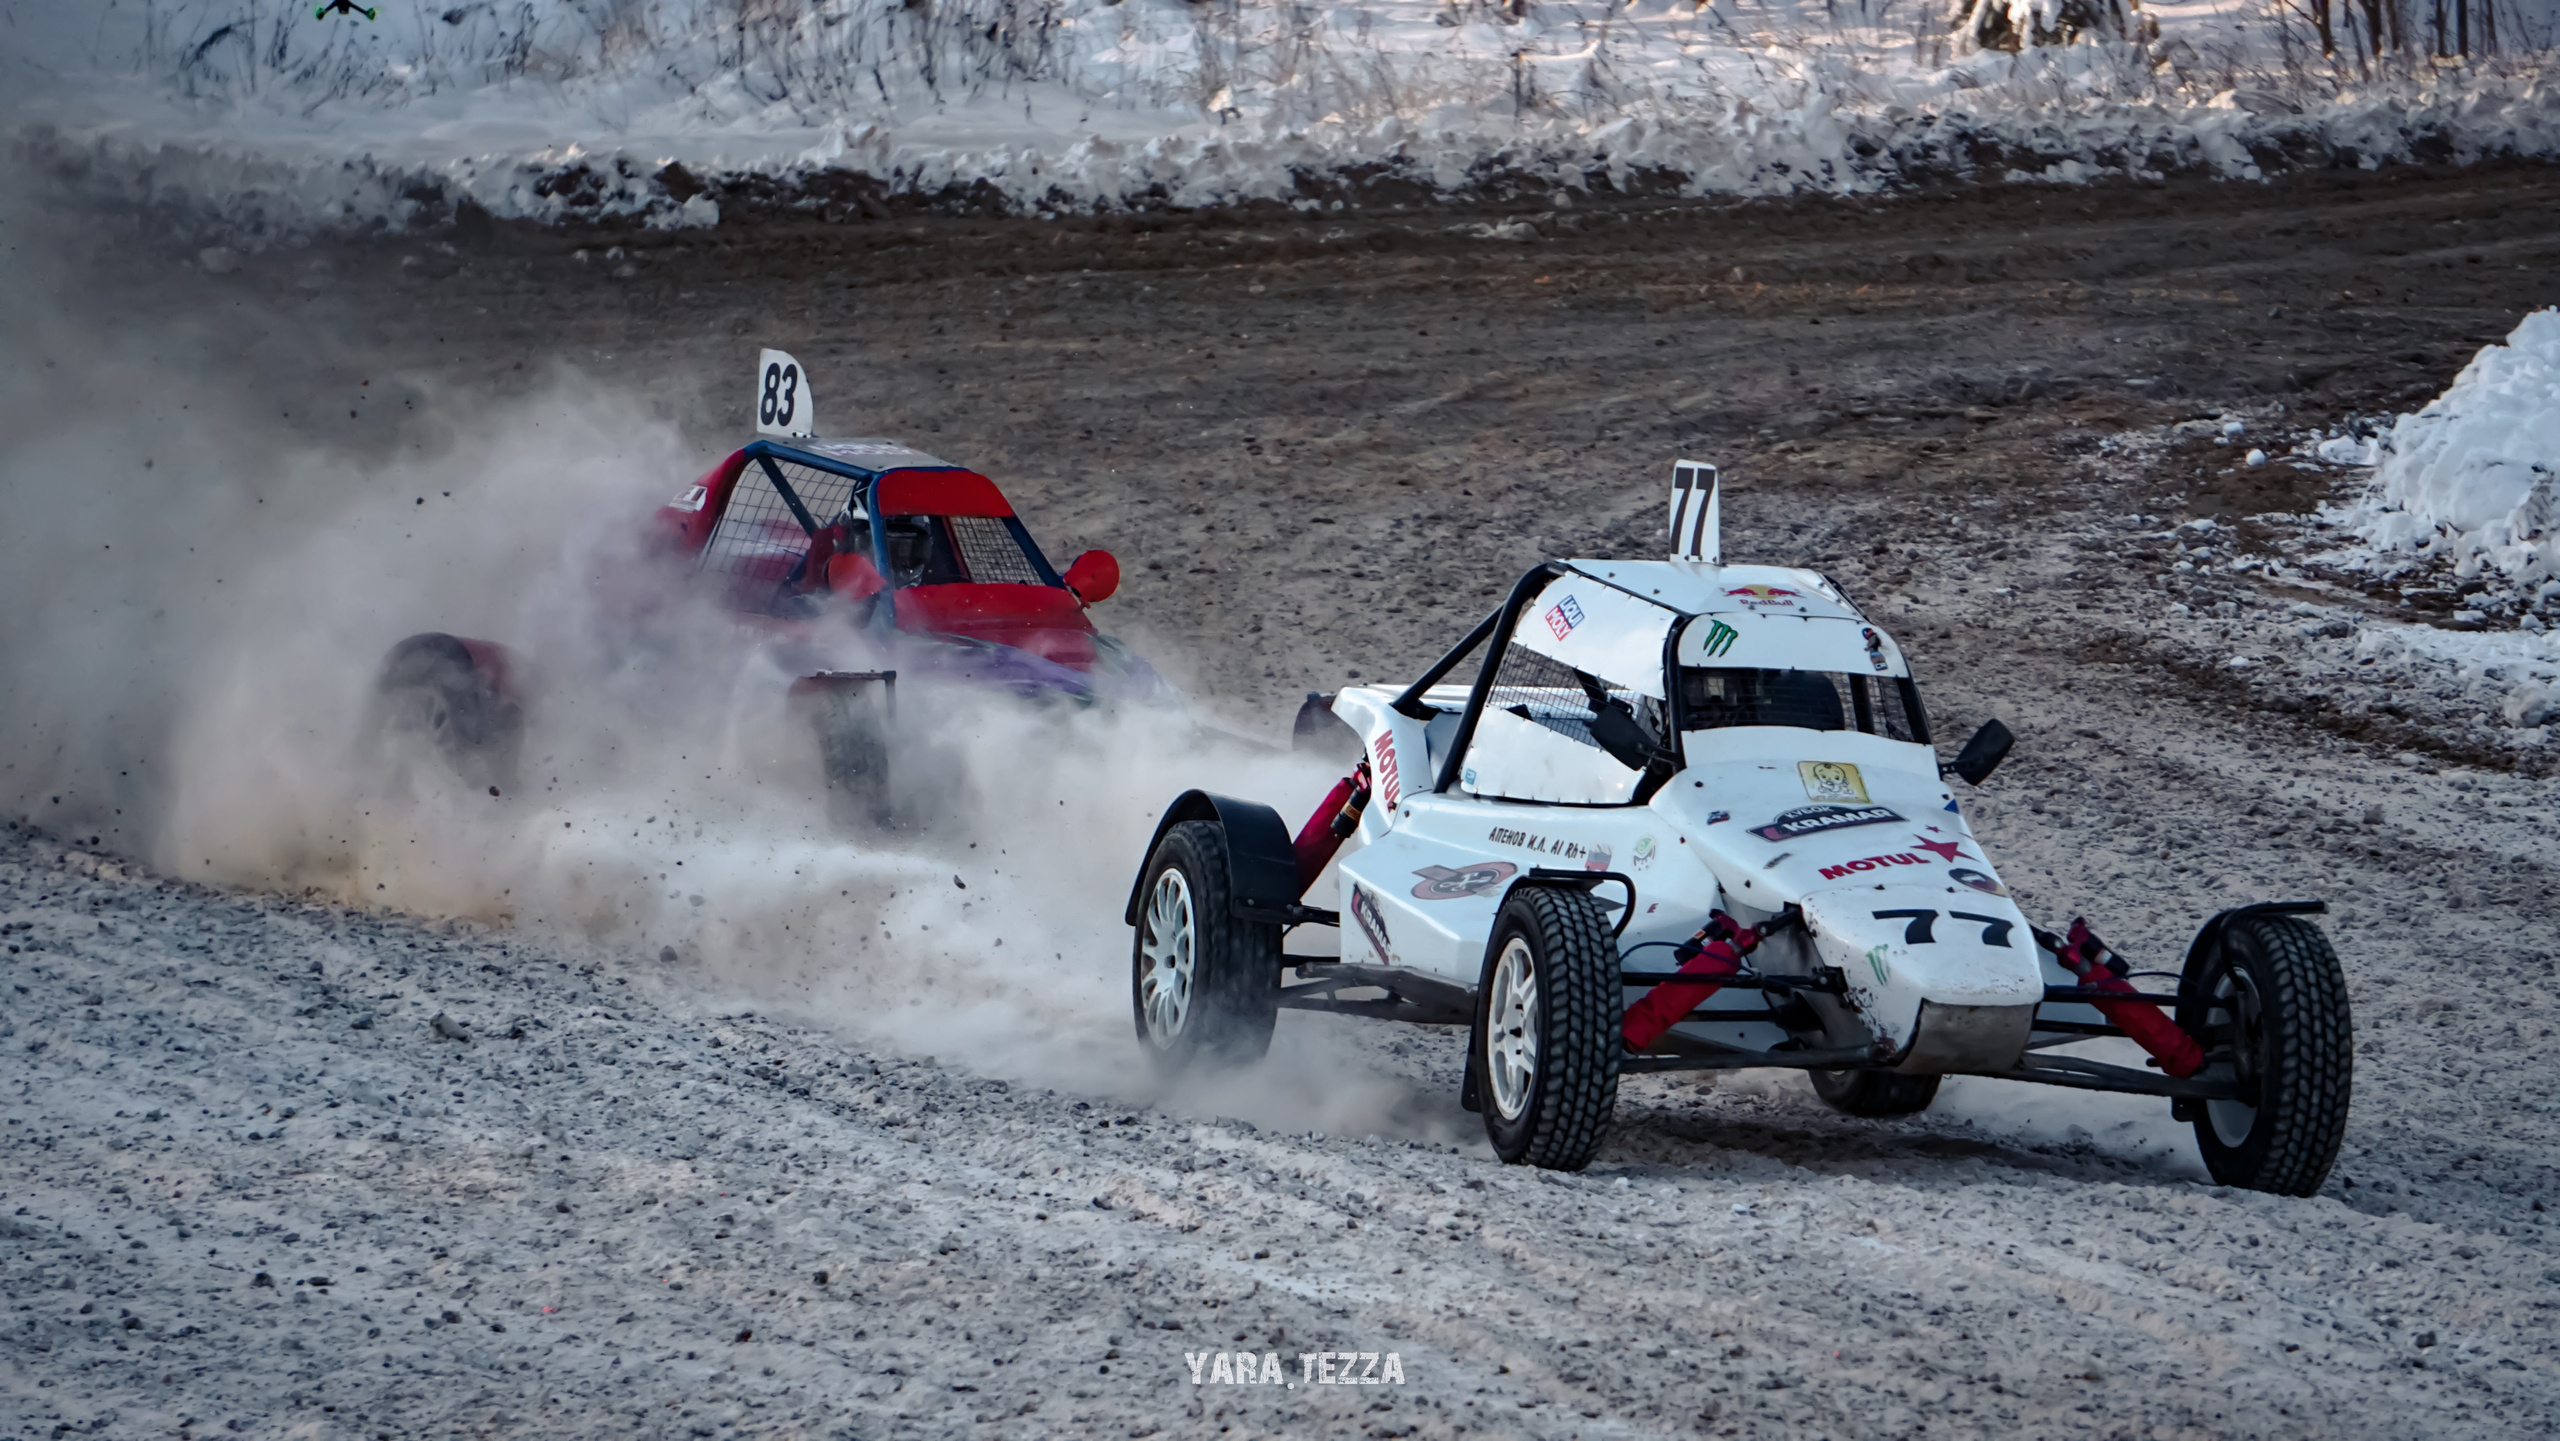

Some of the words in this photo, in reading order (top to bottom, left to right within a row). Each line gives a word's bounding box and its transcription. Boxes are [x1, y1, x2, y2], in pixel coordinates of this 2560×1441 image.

[761, 362, 798, 427] 83
[1670, 467, 1716, 556] 77
[1546, 605, 1571, 640] MOLY
[1558, 595, 1584, 628] LIQUI
[1374, 729, 1400, 813] MOTUL
[1782, 808, 1895, 832] KRAMAR
[1818, 853, 1932, 880] MOTUL
[1871, 908, 2015, 949] 77
